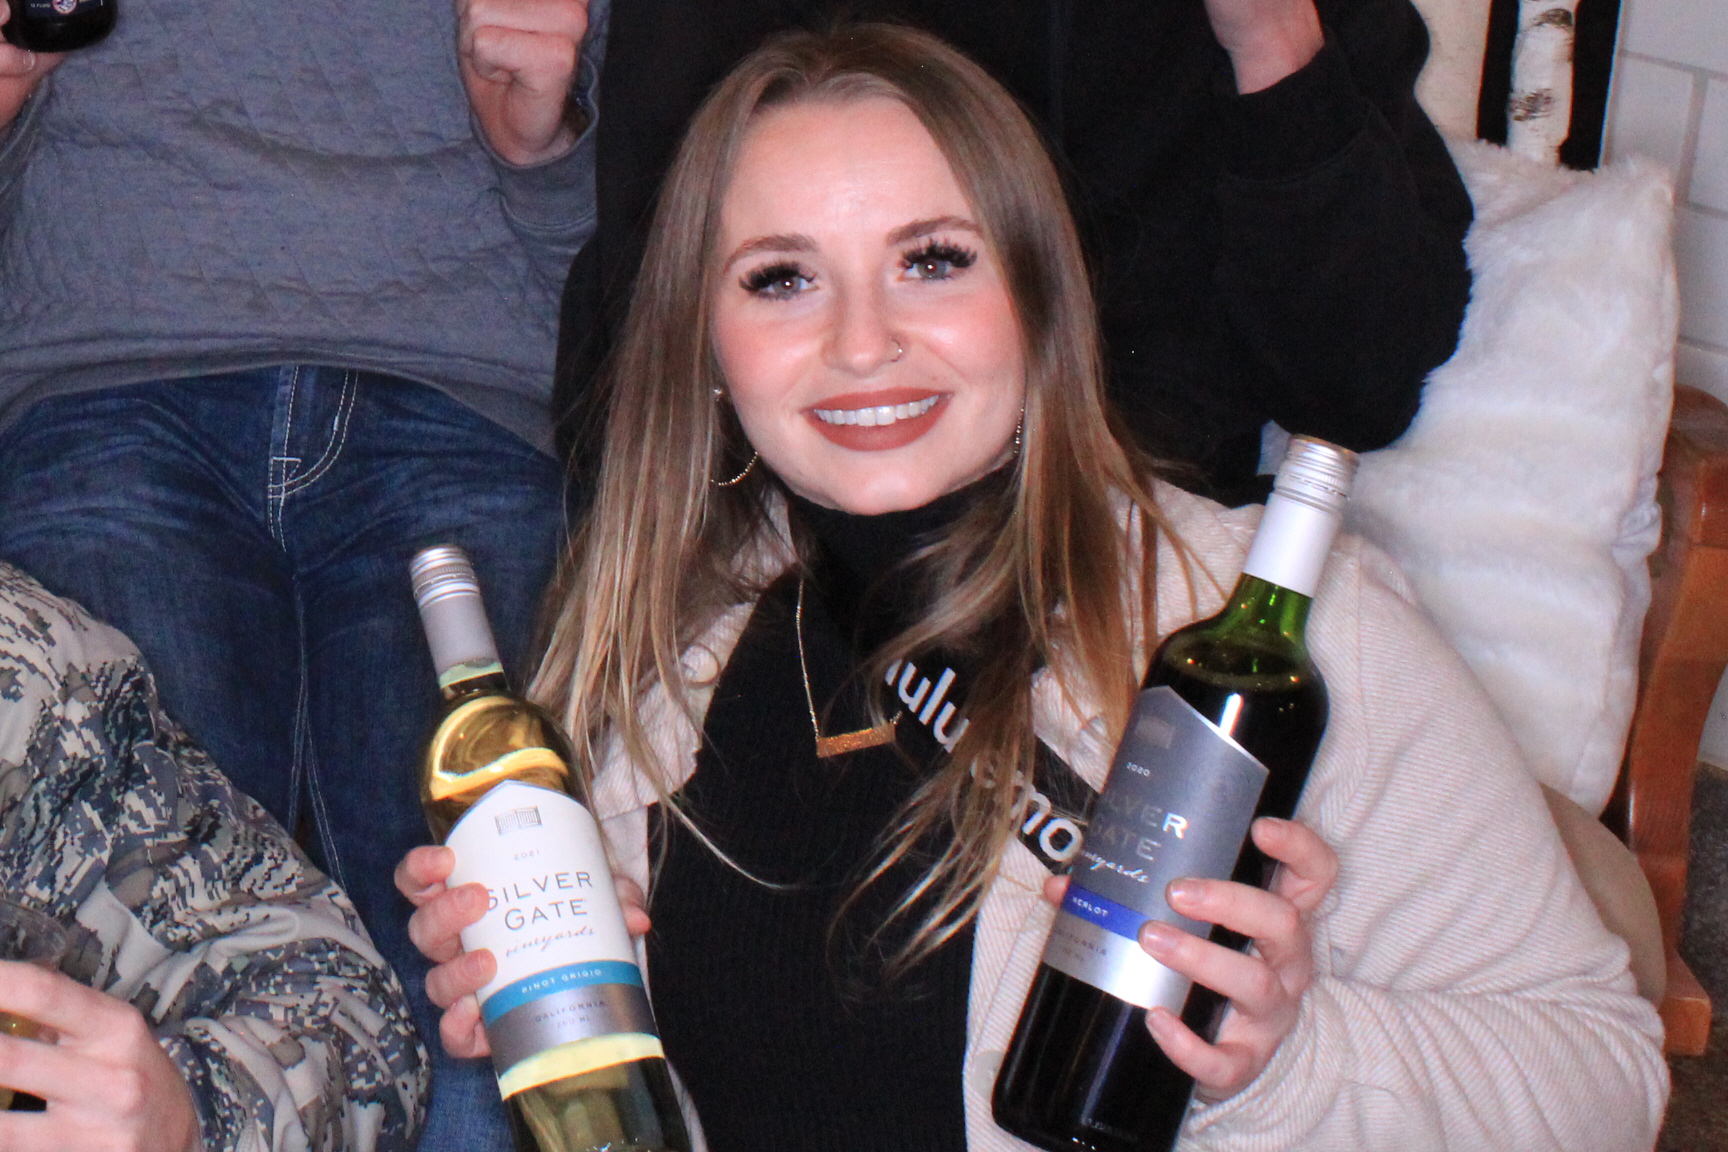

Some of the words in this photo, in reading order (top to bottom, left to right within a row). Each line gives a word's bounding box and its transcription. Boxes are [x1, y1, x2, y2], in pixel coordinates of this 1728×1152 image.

[1126, 761, 1152, 778] 2020
[504, 898, 588, 932] GATE
[1072, 895, 1110, 918] MERLOT
[504, 924, 596, 958] vineyards
[521, 977, 557, 995] PINOT
[561, 968, 603, 982] GRIGIO
[534, 999, 606, 1023] CALIFORNIA
